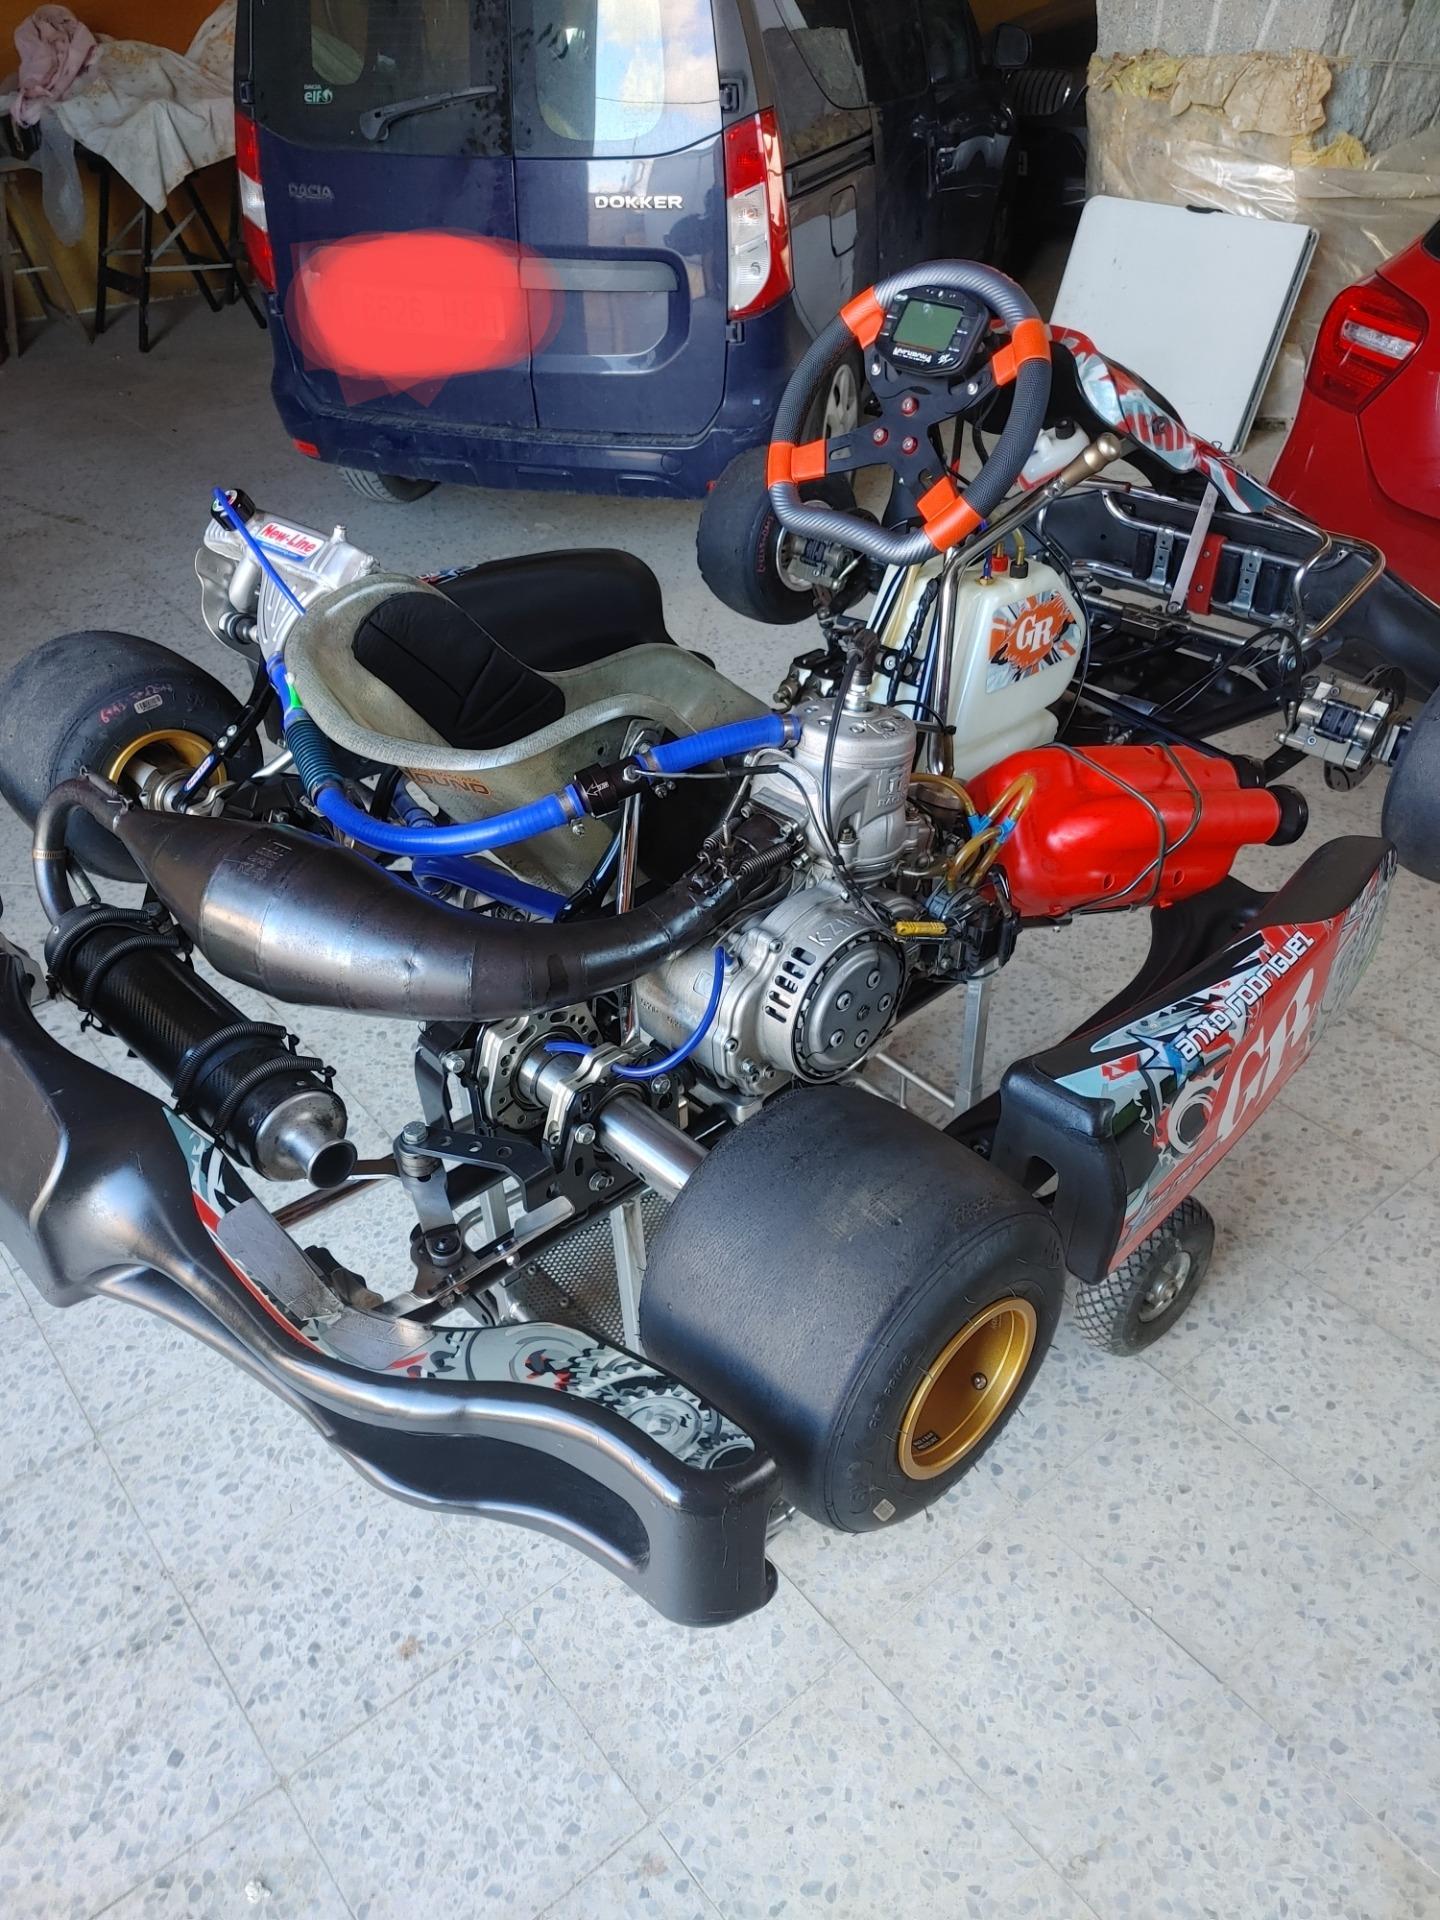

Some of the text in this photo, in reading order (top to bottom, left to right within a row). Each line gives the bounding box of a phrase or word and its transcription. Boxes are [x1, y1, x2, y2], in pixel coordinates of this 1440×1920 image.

[593, 194, 684, 210] DOKKER
[260, 523, 319, 554] New-Line
[1015, 613, 1055, 654] GR
